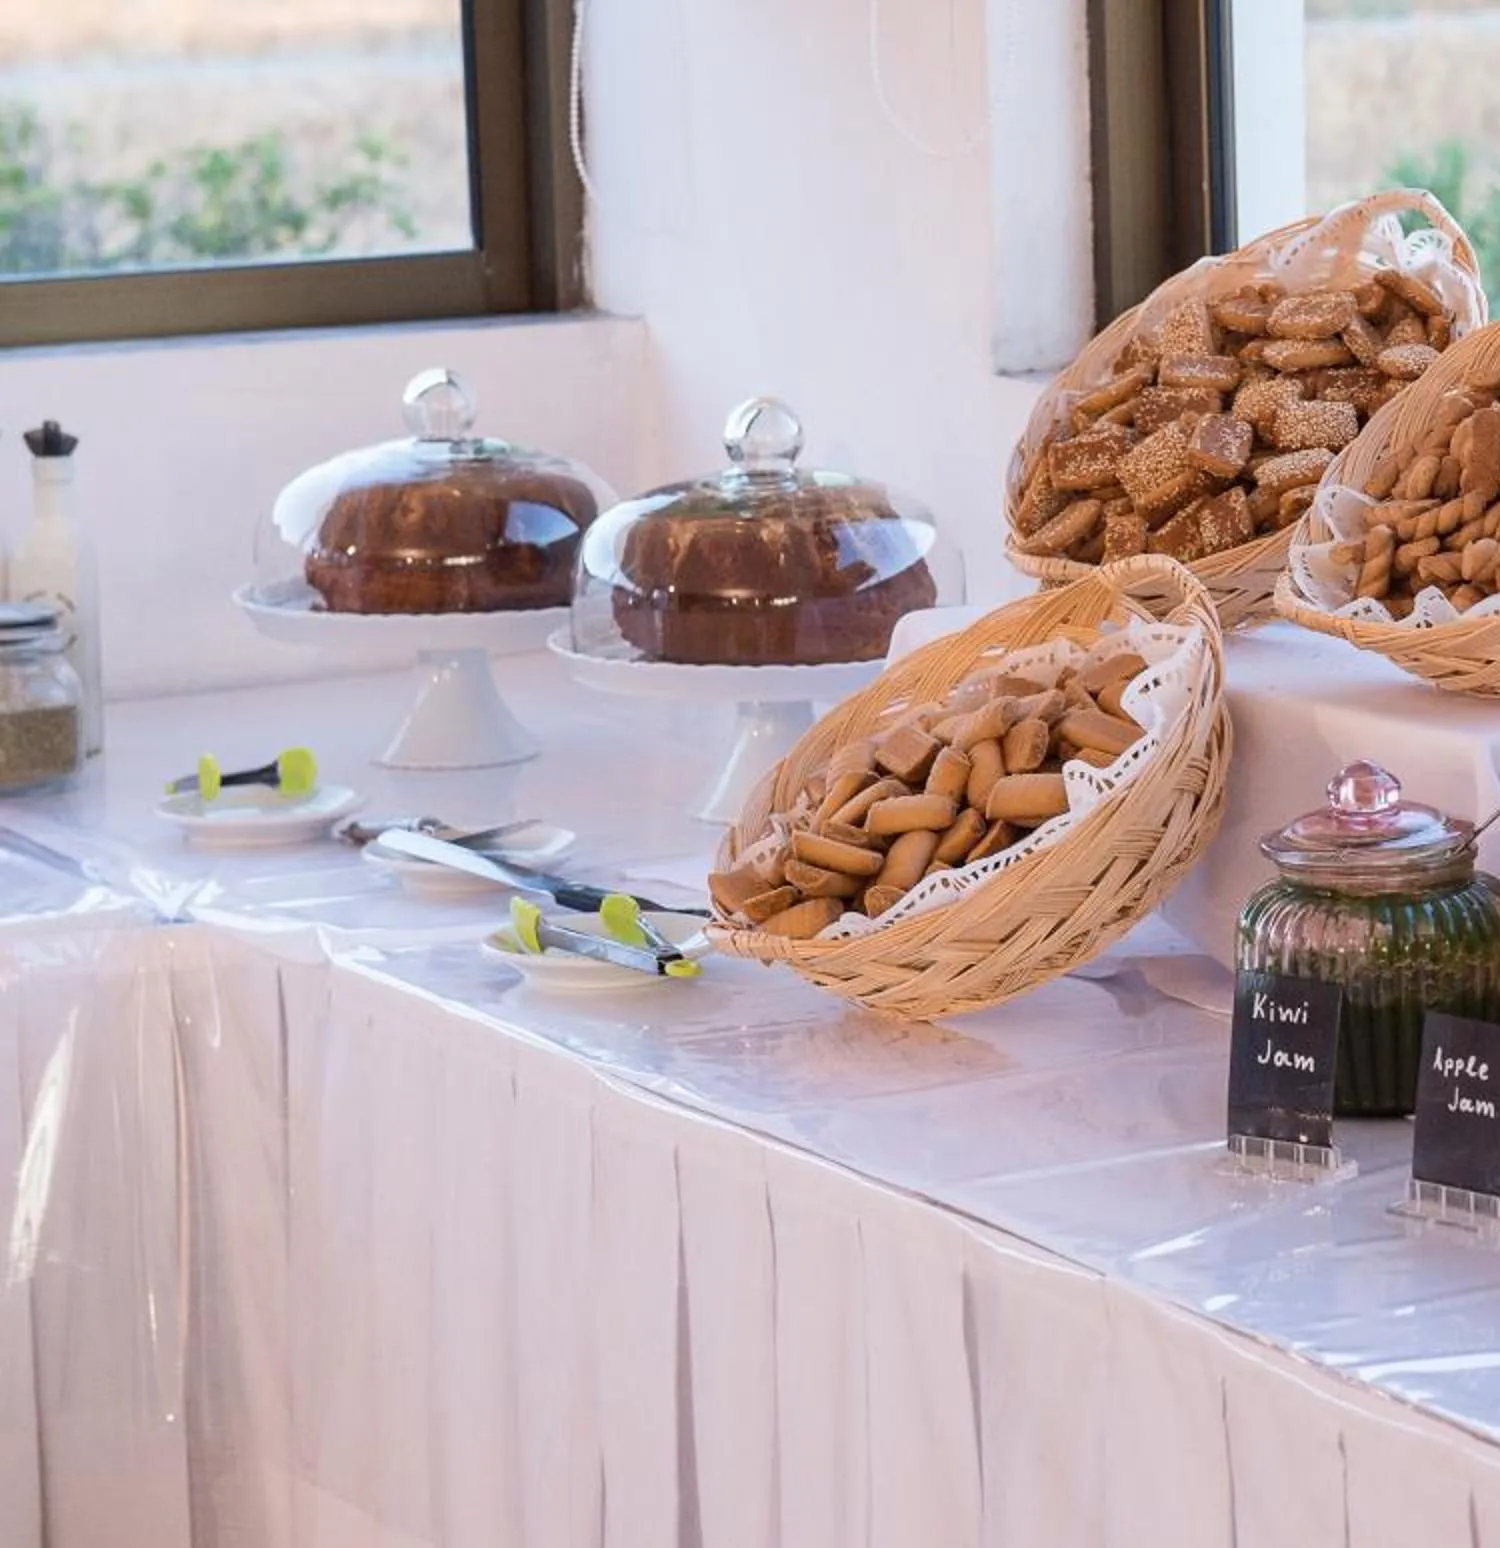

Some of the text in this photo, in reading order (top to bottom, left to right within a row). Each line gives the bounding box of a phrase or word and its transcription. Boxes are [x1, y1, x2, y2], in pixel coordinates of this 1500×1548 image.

[1252, 992, 1309, 1025] Kiwi
[1257, 1039, 1316, 1073] Jam
[1432, 1046, 1489, 1081] Apple
[1447, 1087, 1495, 1119] Jam
